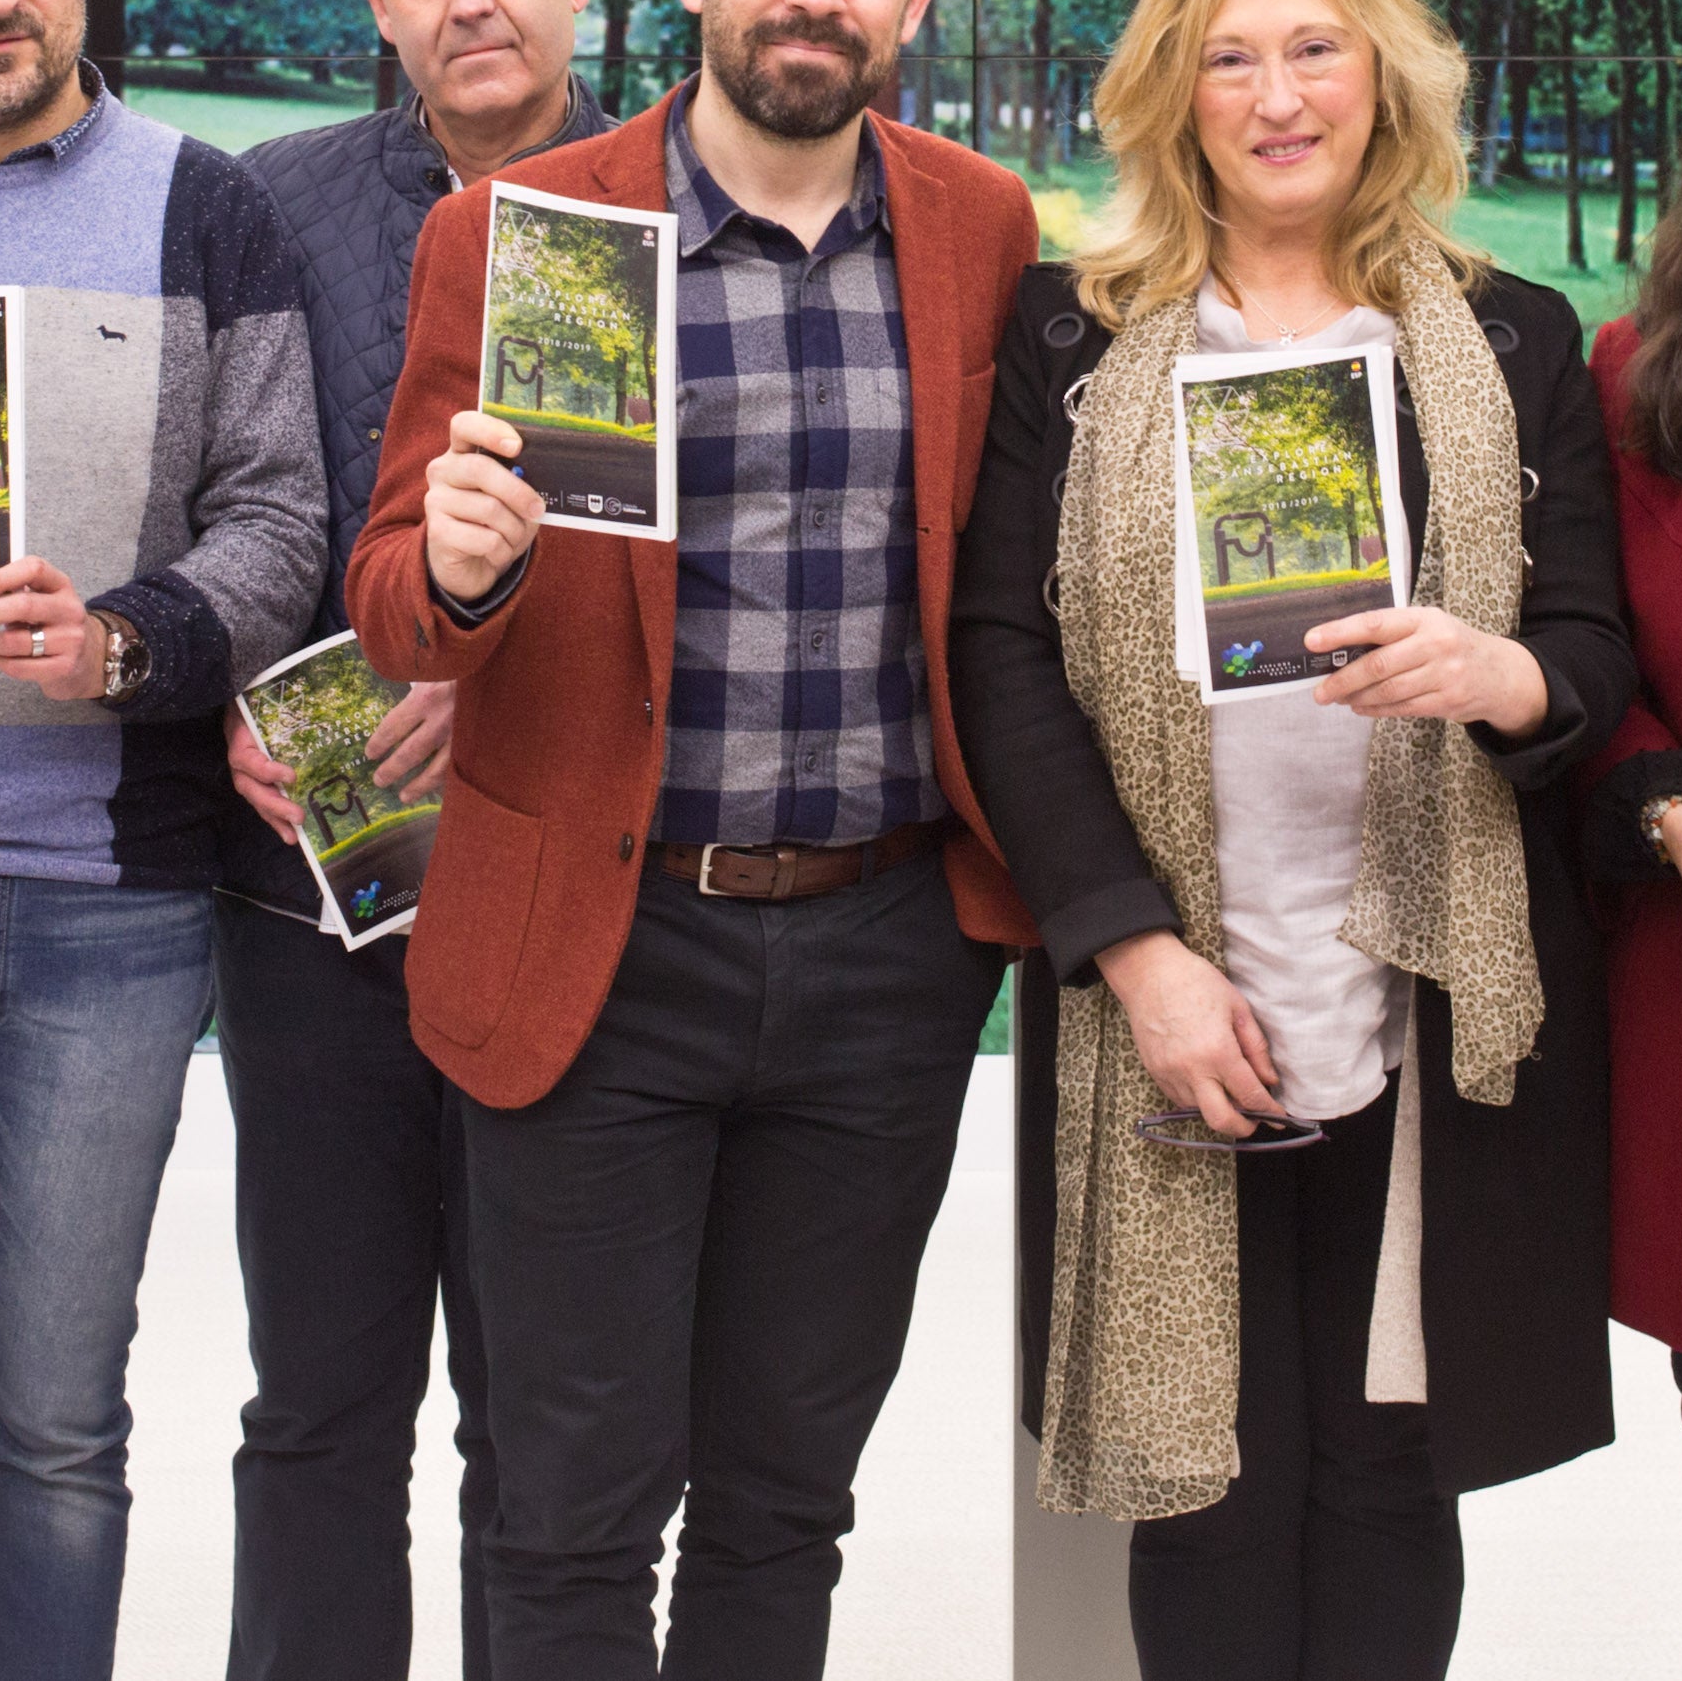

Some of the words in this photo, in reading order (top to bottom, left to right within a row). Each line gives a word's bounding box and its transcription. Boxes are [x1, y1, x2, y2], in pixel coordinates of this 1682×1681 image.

[509, 292, 631, 320] SANSEBASTIAN
[535, 286, 607, 306] EXPLORE
[554, 312, 619, 331] REGION
[1250, 444, 1327, 464] EXPLORE
[1219, 451, 1353, 480] SANSEBASTIAN
[1276, 465, 1343, 483] REGION
